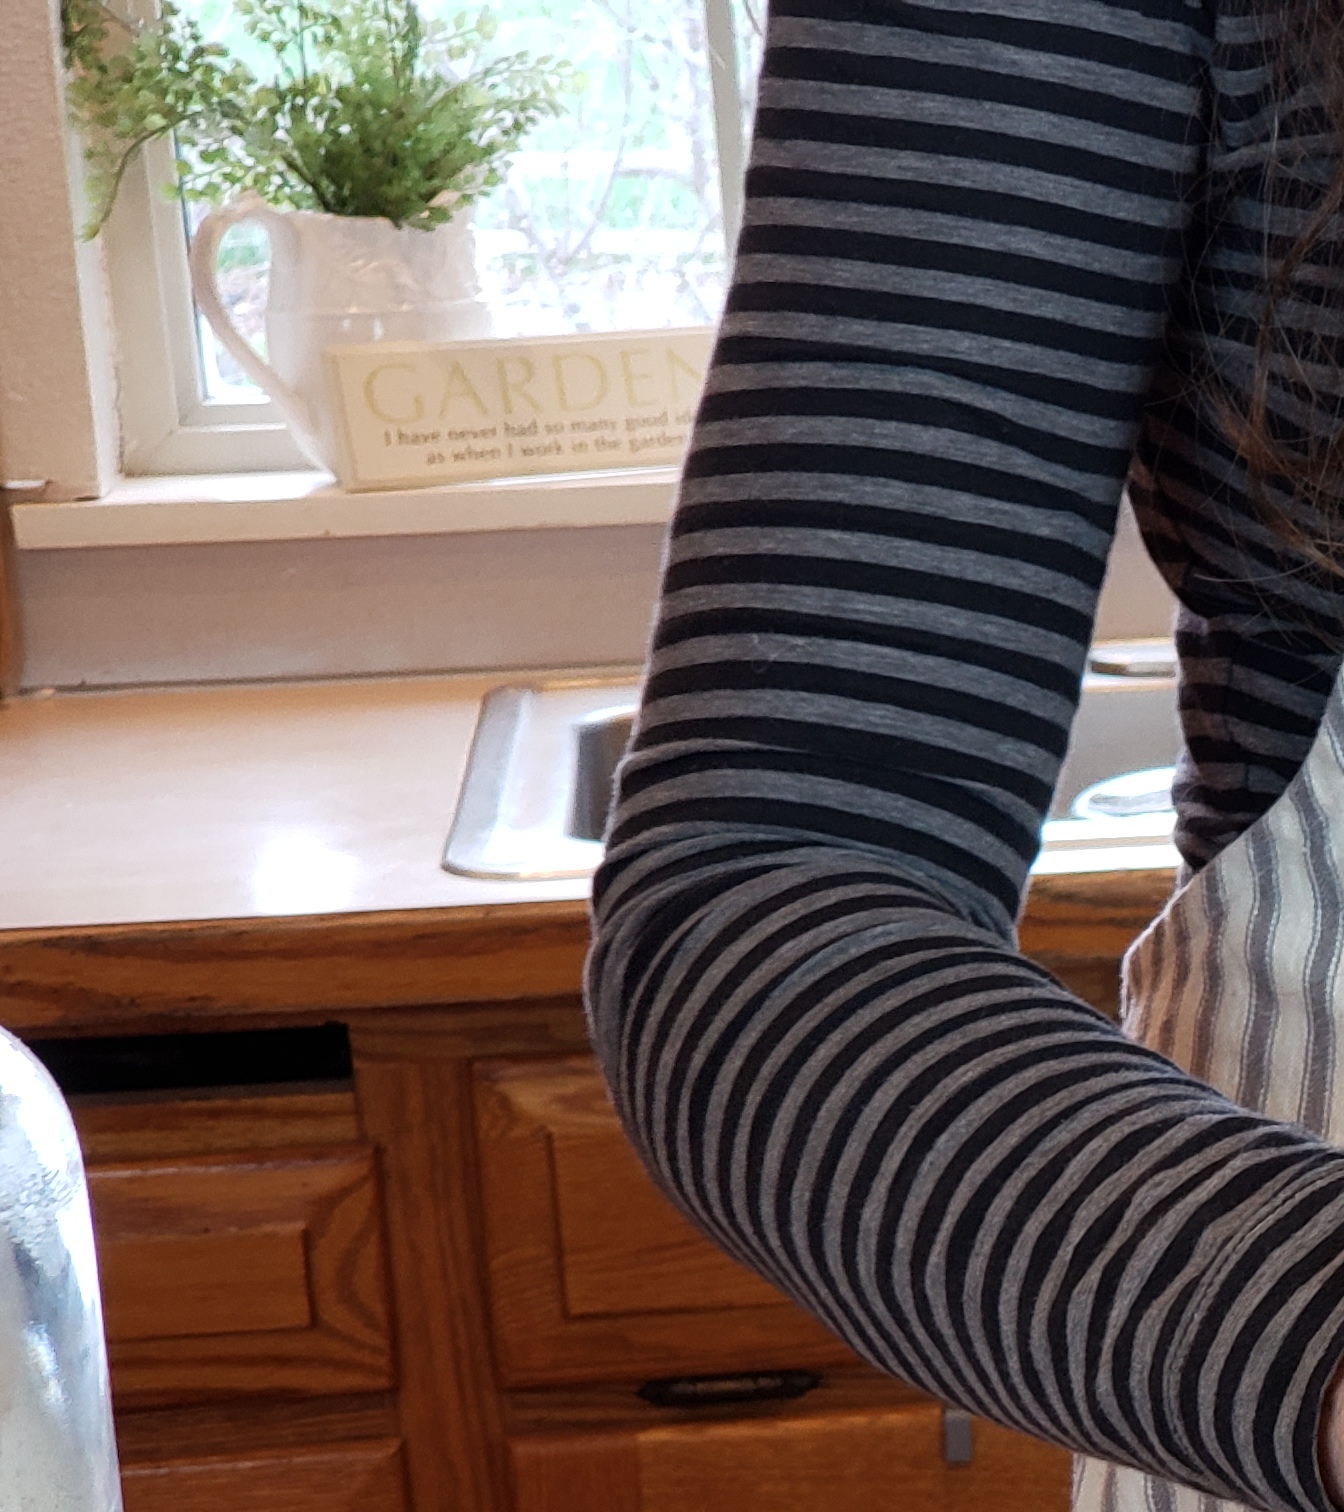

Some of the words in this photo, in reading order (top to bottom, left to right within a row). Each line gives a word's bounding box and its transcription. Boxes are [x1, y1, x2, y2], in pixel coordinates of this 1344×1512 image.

[363, 346, 704, 424] GARDEN
[384, 429, 391, 446] I
[397, 428, 440, 445] have
[447, 427, 496, 441] never
[504, 417, 537, 437] had
[545, 422, 564, 435] so
[571, 419, 616, 433] many
[626, 411, 668, 431] good
[522, 440, 563, 457] work
[593, 436, 620, 451] the
